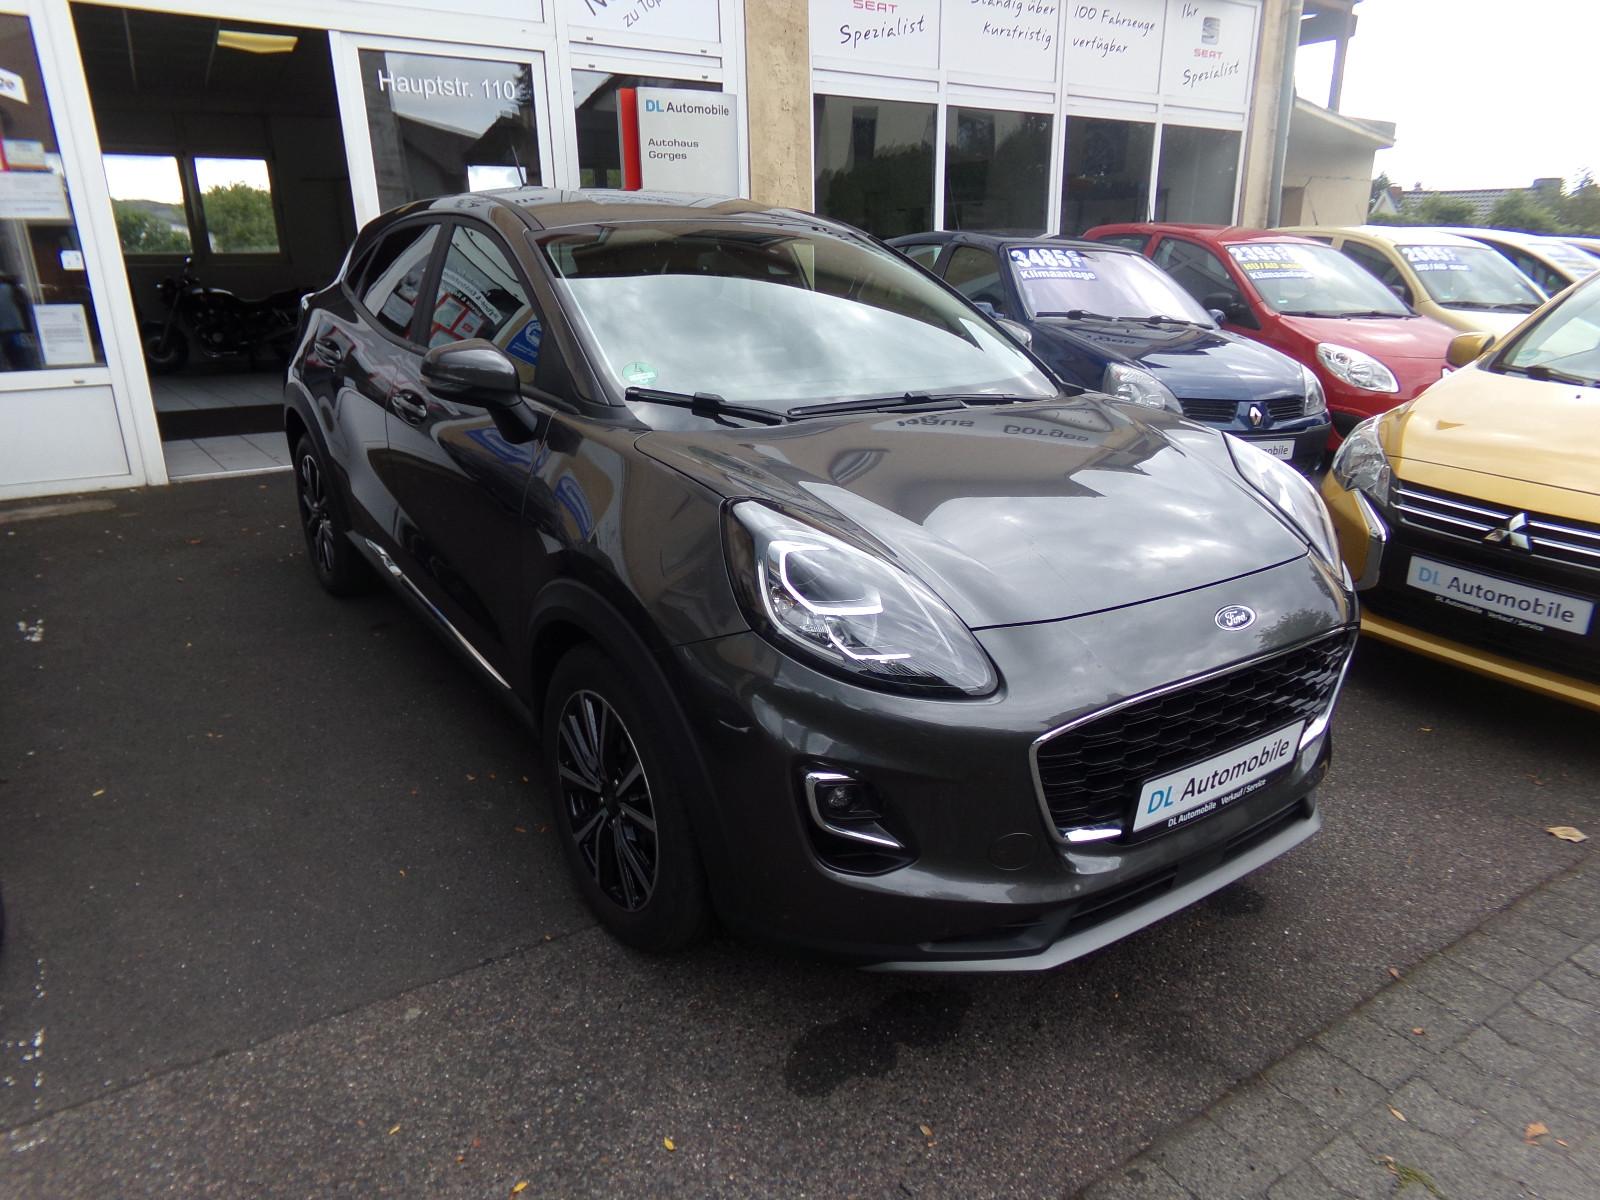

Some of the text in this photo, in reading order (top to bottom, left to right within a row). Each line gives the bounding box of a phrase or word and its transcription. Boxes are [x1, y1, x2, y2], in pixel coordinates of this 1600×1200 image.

[853, 0, 898, 14] SEAT
[971, 0, 1022, 17] ndig
[1182, 3, 1199, 17] Ihr
[1074, 5, 1155, 37] 100 Fahrzeuge
[840, 15, 924, 48] Spezialist
[1194, 48, 1223, 59] SEAT
[1182, 59, 1239, 88] Spezialist
[378, 69, 515, 100] Hauptstr. 110
[645, 99, 729, 116] DL Automobile
[648, 138, 699, 148] Autohaus
[648, 150, 687, 161] Gorges
[1020, 270, 1096, 280] Klimaanlage
[1418, 566, 1575, 623] DL Automobile
[1224, 610, 1248, 626] Ford
[1147, 738, 1290, 815] DL Automobile
[1168, 817, 1177, 828] DL
[1178, 801, 1216, 822] Automobile
